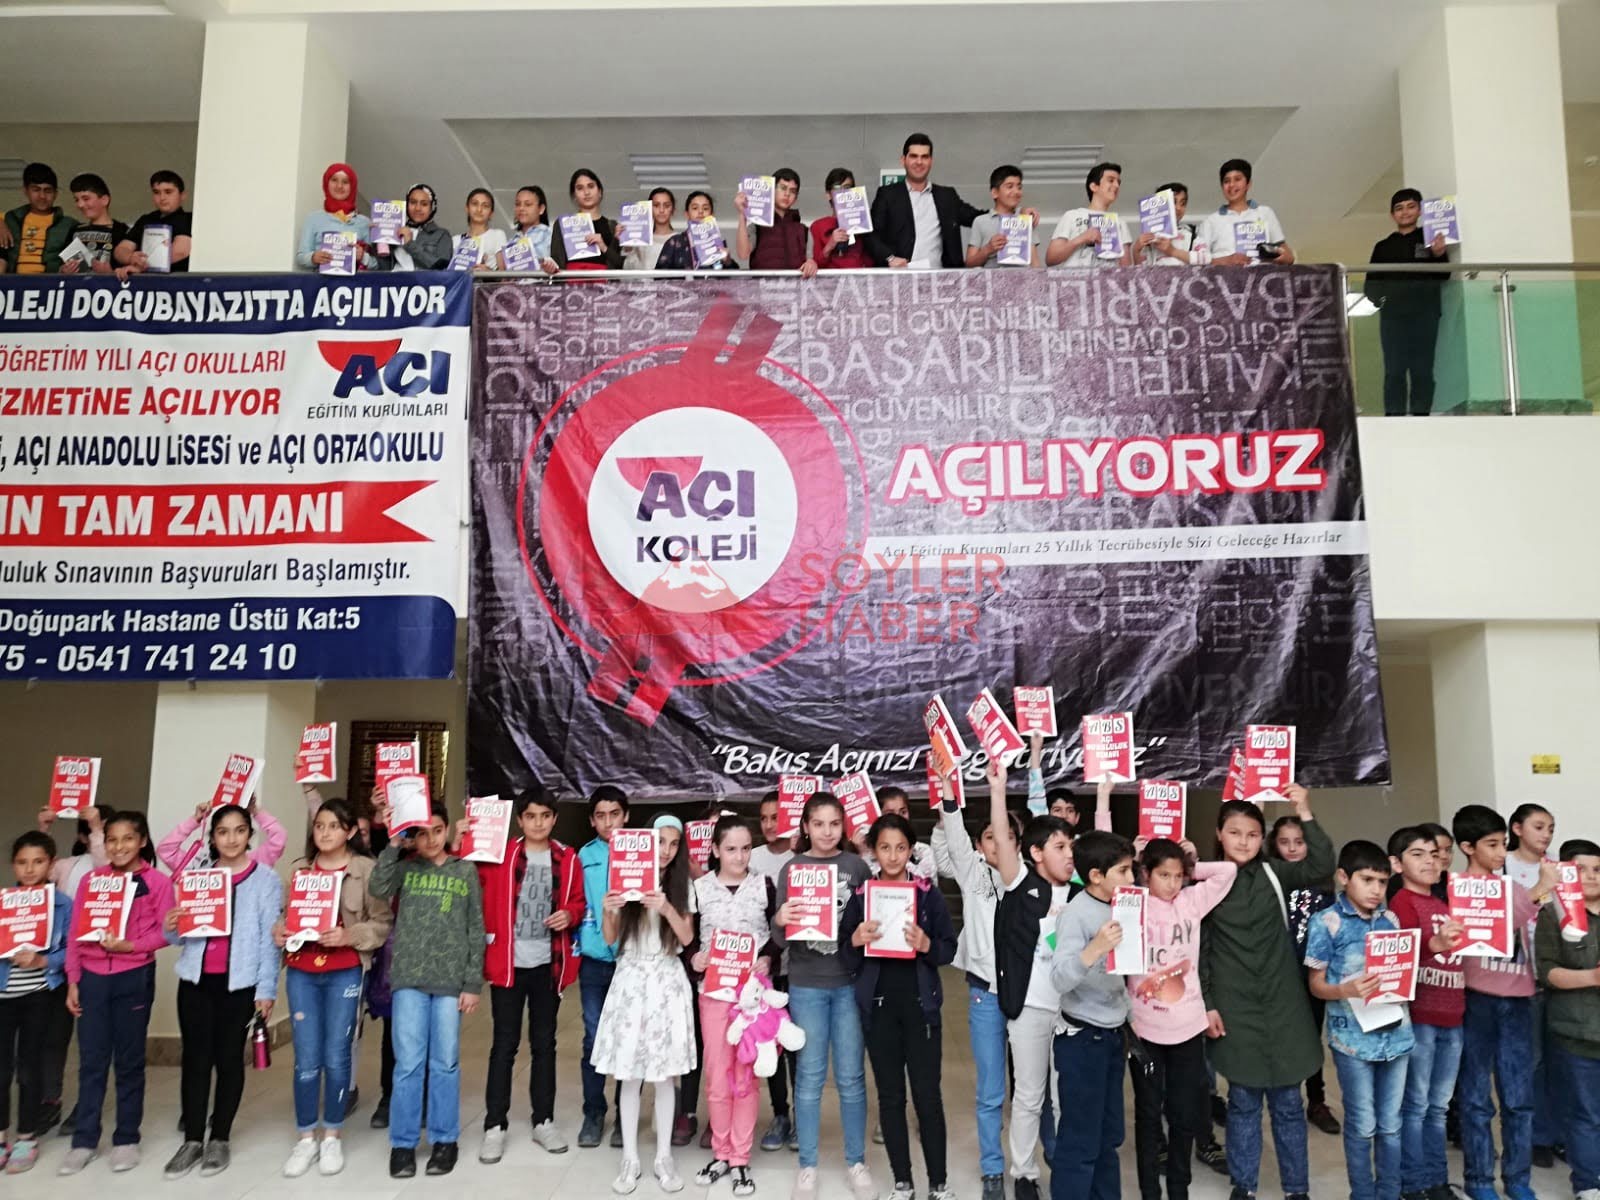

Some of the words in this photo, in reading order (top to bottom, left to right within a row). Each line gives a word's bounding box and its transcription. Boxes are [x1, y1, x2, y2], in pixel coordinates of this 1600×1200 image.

[0, 281, 65, 320] LEJİ
[71, 281, 303, 323] DOĞUBAYAZITTA
[312, 285, 447, 326] AÇILIYOR
[96, 348, 132, 371] YILI
[137, 350, 177, 377] AÇI
[183, 350, 286, 375] OKULLARI
[333, 349, 452, 398] AÇI
[139, 386, 281, 423] AÇILIYOR
[307, 402, 357, 419] EĞİTİM
[362, 403, 448, 418] KURUMLARI
[13, 436, 50, 475] AÇI
[56, 436, 160, 466] ANADOLU
[238, 438, 260, 465] ve
[267, 434, 305, 474] AÇI
[313, 431, 444, 465] ORTAOKULU
[888, 431, 1324, 513] AÇILIYORUZ
[636, 469, 755, 522] AÇI
[58, 495, 154, 536] TAM
[168, 491, 344, 537] ZAMANI
[636, 524, 757, 563] KOLEJİ
[909, 545, 955, 558] Eğitim
[961, 543, 1030, 556] Kurumları
[1035, 542, 1050, 553] 25
[1056, 539, 1093, 552] Yıllık
[1098, 536, 1182, 553] Tecrübesiyle
[1187, 535, 1212, 549] Sizi
[1217, 533, 1279, 549] Geleceğe
[1283, 530, 1344, 545] Hazırlar
[55, 561, 153, 584] Sınavının
[161, 561, 277, 590] Başvuruları
[287, 558, 411, 590] Başlamıştır.
[0, 609, 116, 637] Doğupark
[123, 610, 219, 632] Hastane
[229, 605, 288, 632] Üstü
[296, 607, 361, 631] Kat:5
[58, 645, 131, 672] 0541
[144, 644, 195, 671] 741
[210, 644, 248, 671] 24
[259, 643, 296, 671] 10
[1087, 717, 1125, 735] ABS
[1251, 731, 1288, 748] ABS
[814, 743, 918, 780] Açınızı
[783, 779, 817, 794] ABS
[1144, 783, 1180, 801] ABS
[615, 834, 651, 852] ABS
[690, 824, 714, 840] AB
[183, 873, 223, 892] ABS
[295, 873, 332, 893] ABS
[791, 869, 829, 887] ABS
[1454, 878, 1502, 898] ABS
[715, 934, 752, 953] ABS
[1370, 936, 1411, 955] ABS
